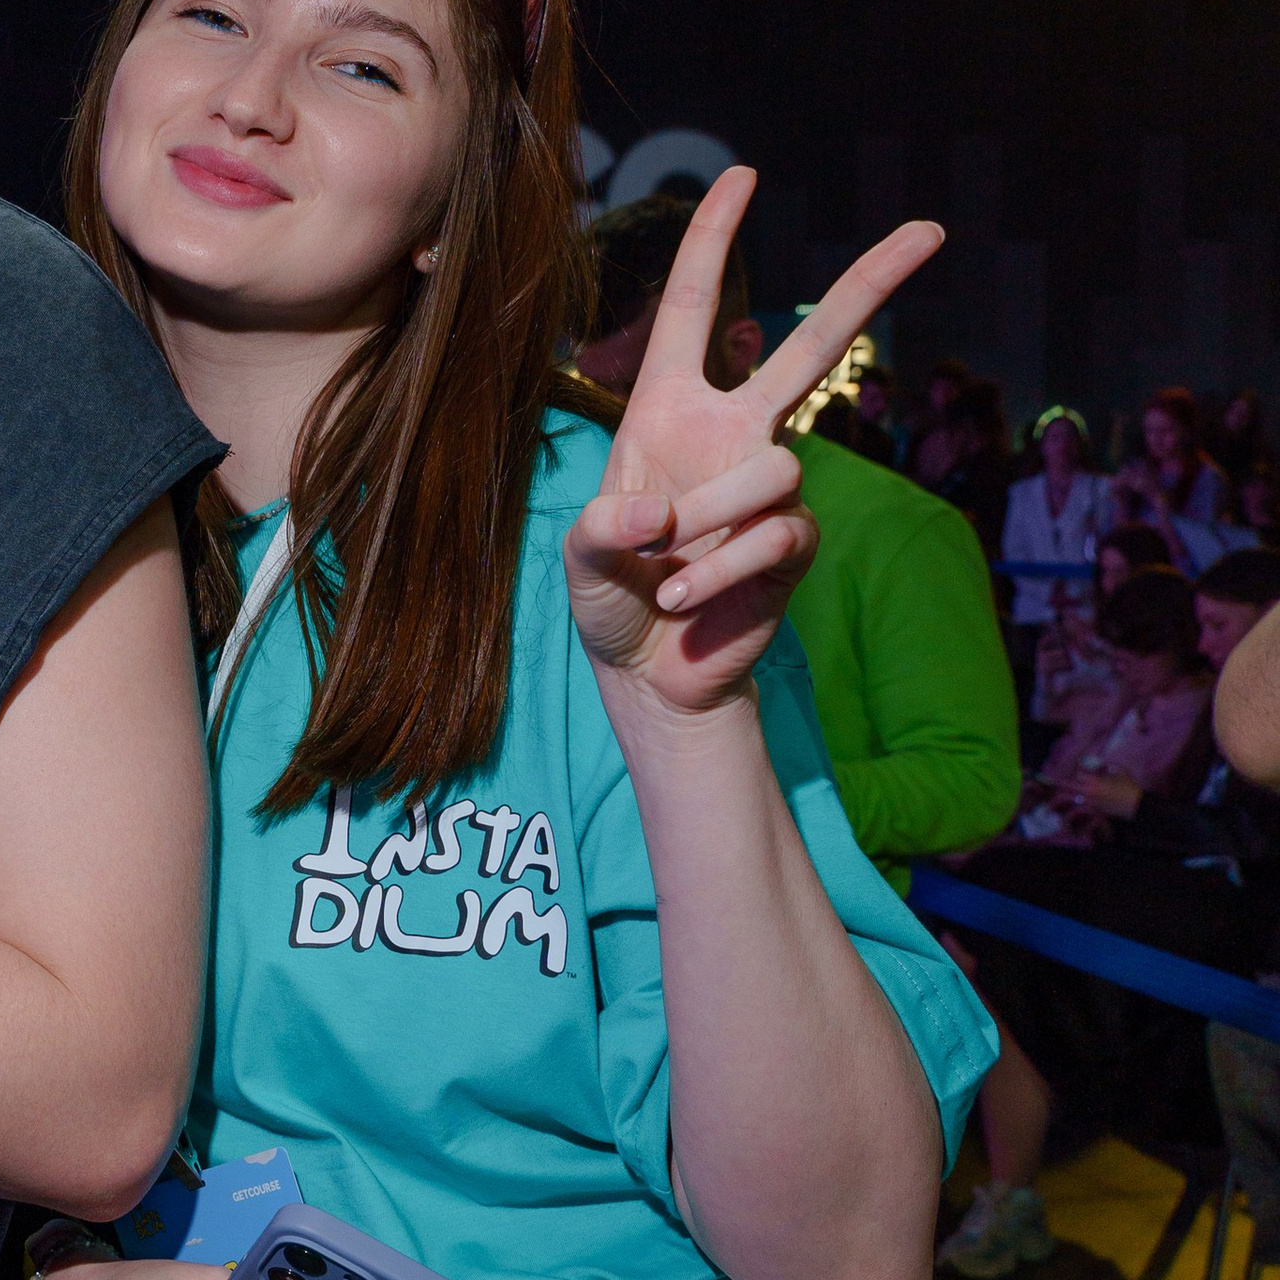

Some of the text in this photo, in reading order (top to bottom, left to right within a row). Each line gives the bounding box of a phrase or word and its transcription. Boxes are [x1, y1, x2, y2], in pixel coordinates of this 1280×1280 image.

[292, 785, 560, 894] INSTA
[289, 877, 568, 978] DIUM
[232, 1179, 281, 1202] GETCOURSE
